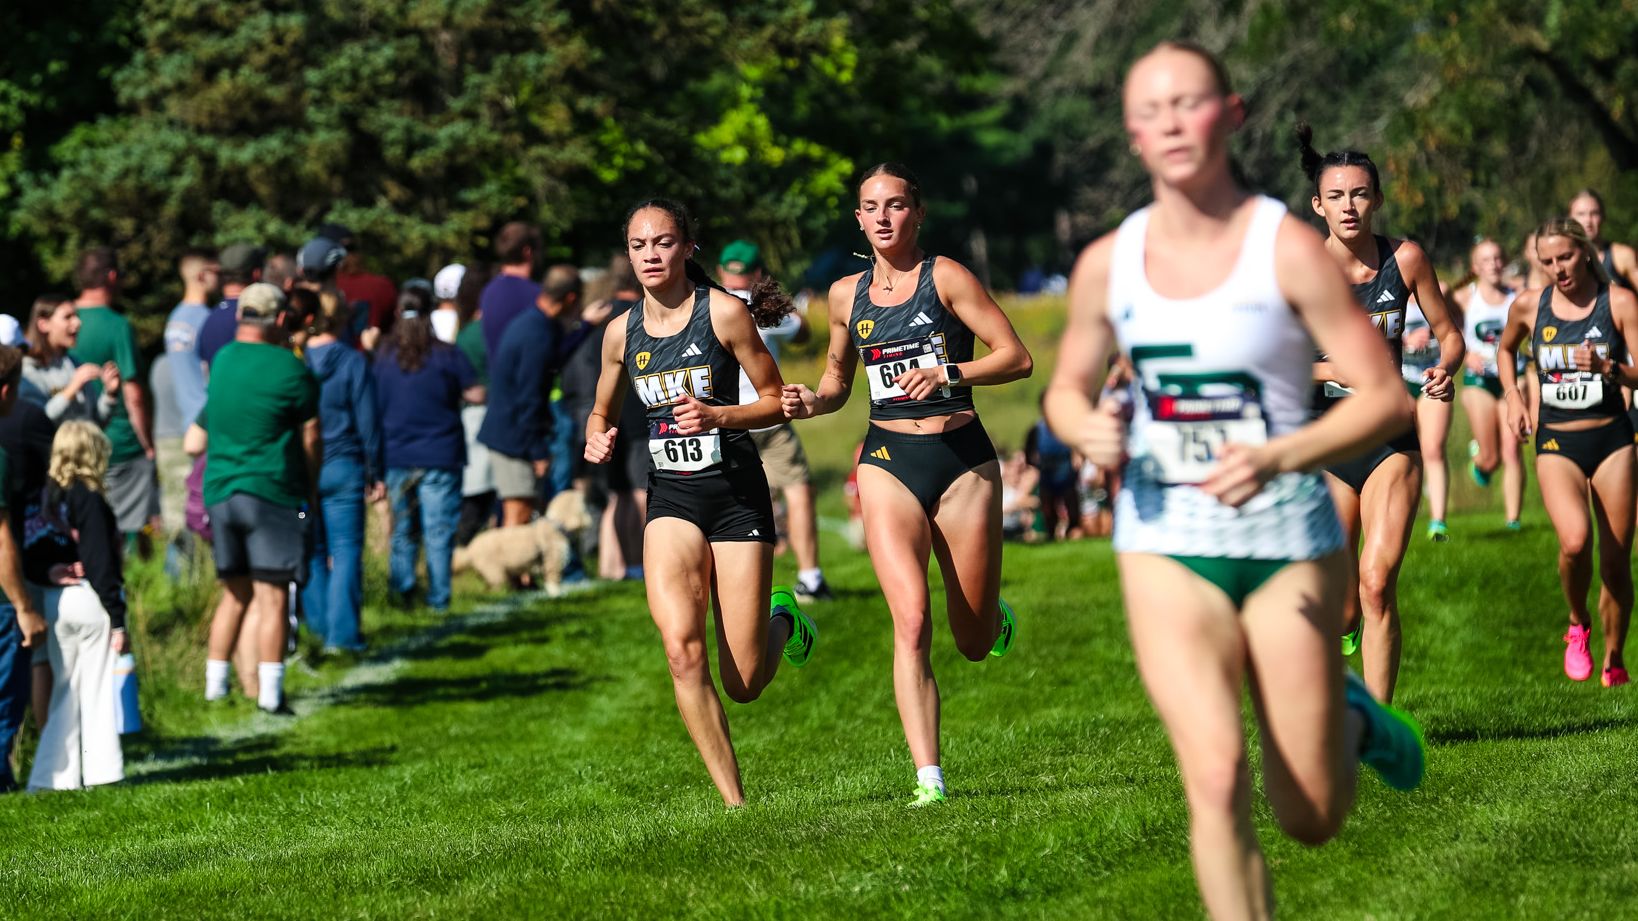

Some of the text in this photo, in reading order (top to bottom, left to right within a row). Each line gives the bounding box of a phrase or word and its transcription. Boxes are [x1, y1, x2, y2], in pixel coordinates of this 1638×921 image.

[882, 342, 920, 355] PRIMETIME
[634, 365, 713, 409] MKE
[1556, 384, 1588, 401] 607
[663, 438, 703, 463] 613
